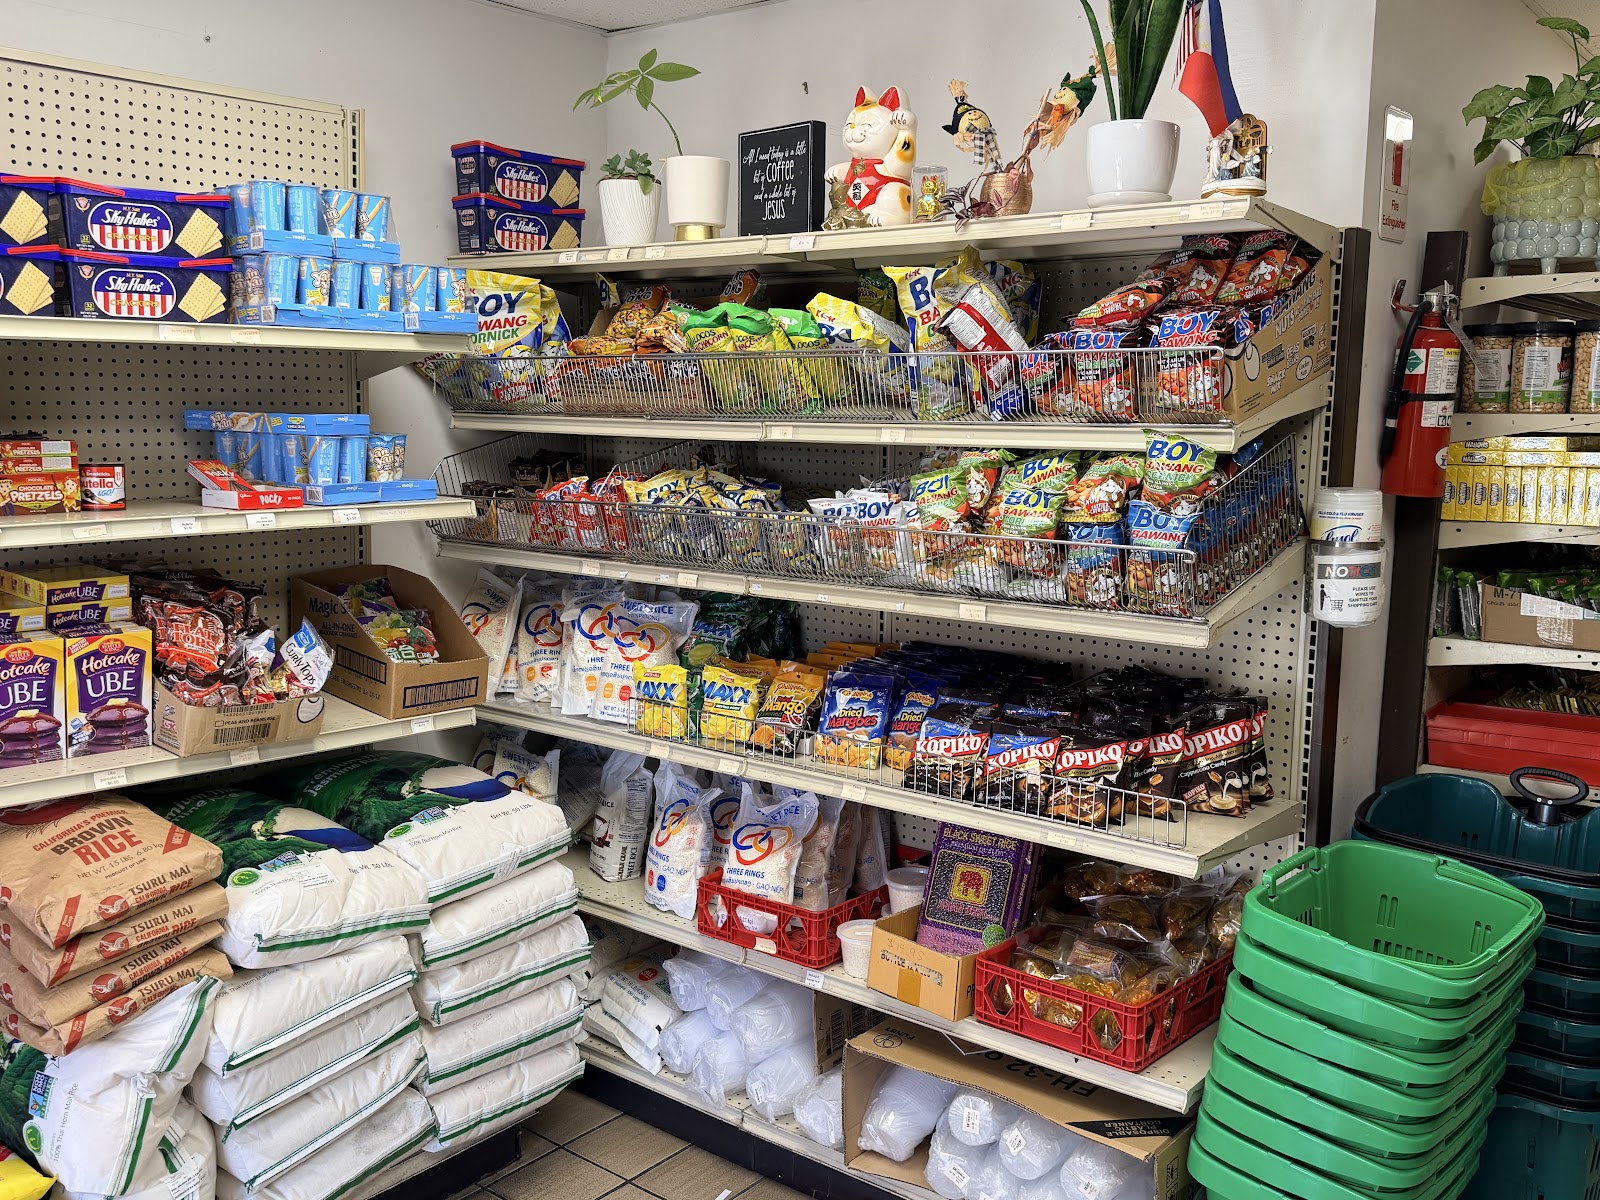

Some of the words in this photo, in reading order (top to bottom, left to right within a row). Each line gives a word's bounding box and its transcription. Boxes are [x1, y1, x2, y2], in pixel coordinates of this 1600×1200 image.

[503, 166, 539, 183] SkyFlakes
[101, 208, 158, 228] SkyFlakes
[503, 218, 539, 234] SkyFlakes
[1383, 214, 1406, 230] Extinguisher
[107, 233, 157, 242] CRACKERS
[105, 275, 162, 293] SkyFlakes
[110, 299, 160, 307] CRACKERS
[1159, 311, 1219, 339] BOY
[1275, 308, 1295, 339] NUTS
[1075, 332, 1128, 350] BOY
[1148, 440, 1205, 461] BOY
[1022, 451, 1070, 480] BOY
[1145, 462, 1205, 473] BAWANG
[915, 475, 950, 497] BOY
[10, 490, 64, 502] PRETZELS
[1004, 489, 1056, 508] BOY
[858, 501, 895, 518] BOY
[1003, 507, 1055, 519] BAWANG
[1133, 507, 1194, 531] BOY
[1325, 565, 1376, 577] NOTICE
[51, 590, 77, 603] Hotcake
[76, 585, 99, 598] UBE
[53, 611, 79, 626] Hotcake
[78, 608, 102, 621] UBE
[172, 621, 213, 641] FLAT
[321, 621, 355, 632] ALL-IN-ONE
[69, 638, 86, 651] LIMITED
[71, 641, 90, 654] EDITION
[172, 632, 217, 651] TOPS
[81, 648, 140, 675] Hotcake
[285, 642, 303, 668] Curly
[530, 649, 547, 658] THREE
[0, 655, 51, 681] otcake
[300, 661, 316, 685] Tops
[610, 662, 630, 671] THREE
[86, 670, 135, 698] UBE
[774, 682, 807, 694] Philippine
[759, 696, 806, 715] Mango
[904, 691, 935, 706] Philippine
[839, 707, 863, 717] Dried
[901, 712, 923, 722] Dried
[827, 715, 878, 729] Mangoes
[916, 737, 982, 754] KOPIKO
[988, 742, 1055, 768] KOPIKO
[1180, 764, 1210, 778] Cappuccino
[1210, 760, 1228, 770] Candy
[307, 763, 361, 797] Jasmine
[1183, 783, 1205, 800] KOPIKO
[490, 812, 501, 820] Net
[32, 819, 91, 852] CALIFORNIA'S
[91, 809, 128, 822] PREMIER
[51, 816, 135, 856] BROWN
[409, 839, 421, 847] 100%
[421, 836, 431, 844] Thai
[431, 833, 442, 841] Hom
[442, 828, 453, 836] Mali
[943, 827, 968, 841] BLACK
[970, 832, 996, 847] SWEET
[997, 838, 1018, 850] RICE
[72, 829, 143, 866] RICE
[630, 846, 638, 861] RICE
[77, 870, 92, 880] NET
[110, 860, 120, 868] 15
[136, 845, 152, 855] 6.80
[153, 842, 164, 850] kg
[105, 867, 129, 880] PRODUCT
[136, 857, 147, 865] USA
[129, 875, 168, 896] TSURU
[170, 864, 191, 880] MAI
[726, 867, 745, 878] THREE
[745, 869, 765, 880] RINGS
[135, 885, 168, 903] CALIFORNIA
[169, 877, 194, 894] RICE
[131, 913, 169, 934] TSURU
[172, 904, 194, 919] MAI
[135, 925, 170, 943] CALIFORNIA
[171, 917, 198, 936] RICE
[121, 949, 160, 974] TSURU
[161, 937, 183, 951] MAI
[128, 959, 162, 981] CALIFORNIA
[163, 947, 189, 967] RICE
[137, 975, 174, 997] TSURU
[177, 968, 196, 981] MAI
[33, 1073, 41, 1093] NON
[37, 1074, 45, 1094] GMO
[68, 1083, 78, 1096] Rice
[40, 1077, 54, 1117] VERIFIED
[64, 1095, 73, 1110] Mali
[60, 1110, 69, 1128] Hom
[1104, 1119, 1161, 1128] CONTAINER
[56, 1127, 65, 1143] Thai
[1106, 1128, 1170, 1137] DISPOSABLE
[54, 1143, 62, 1162] 100%
